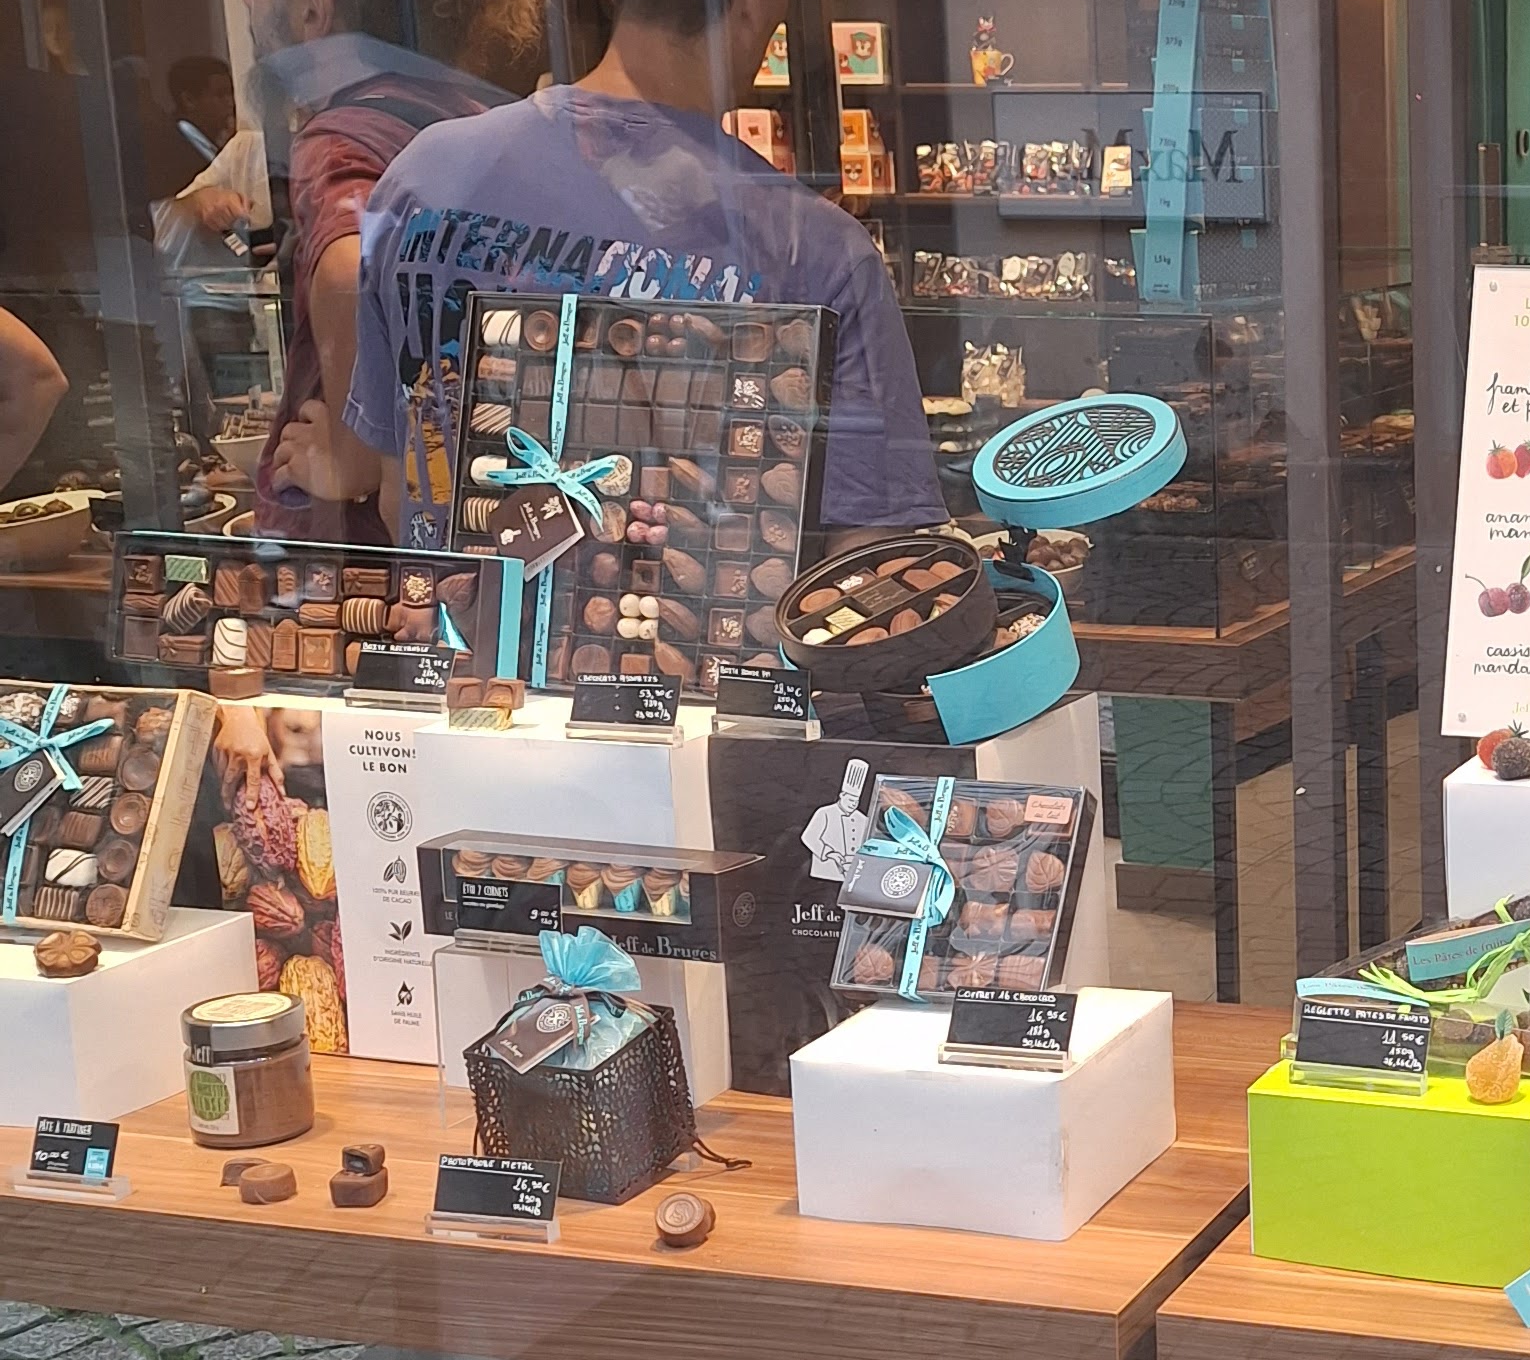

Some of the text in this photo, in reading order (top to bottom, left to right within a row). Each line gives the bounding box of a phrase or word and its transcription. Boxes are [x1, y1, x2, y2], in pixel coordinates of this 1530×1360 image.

[1502, 398, 1521, 414] et
[364, 729, 401, 742] NOUS
[362, 761, 408, 774] LE BON
[791, 904, 842, 925] Jeff de
[641, 935, 717, 961] de Bruges
[1411, 944, 1479, 966] Les Pâtes de
[501, 1160, 536, 1172] METAL
